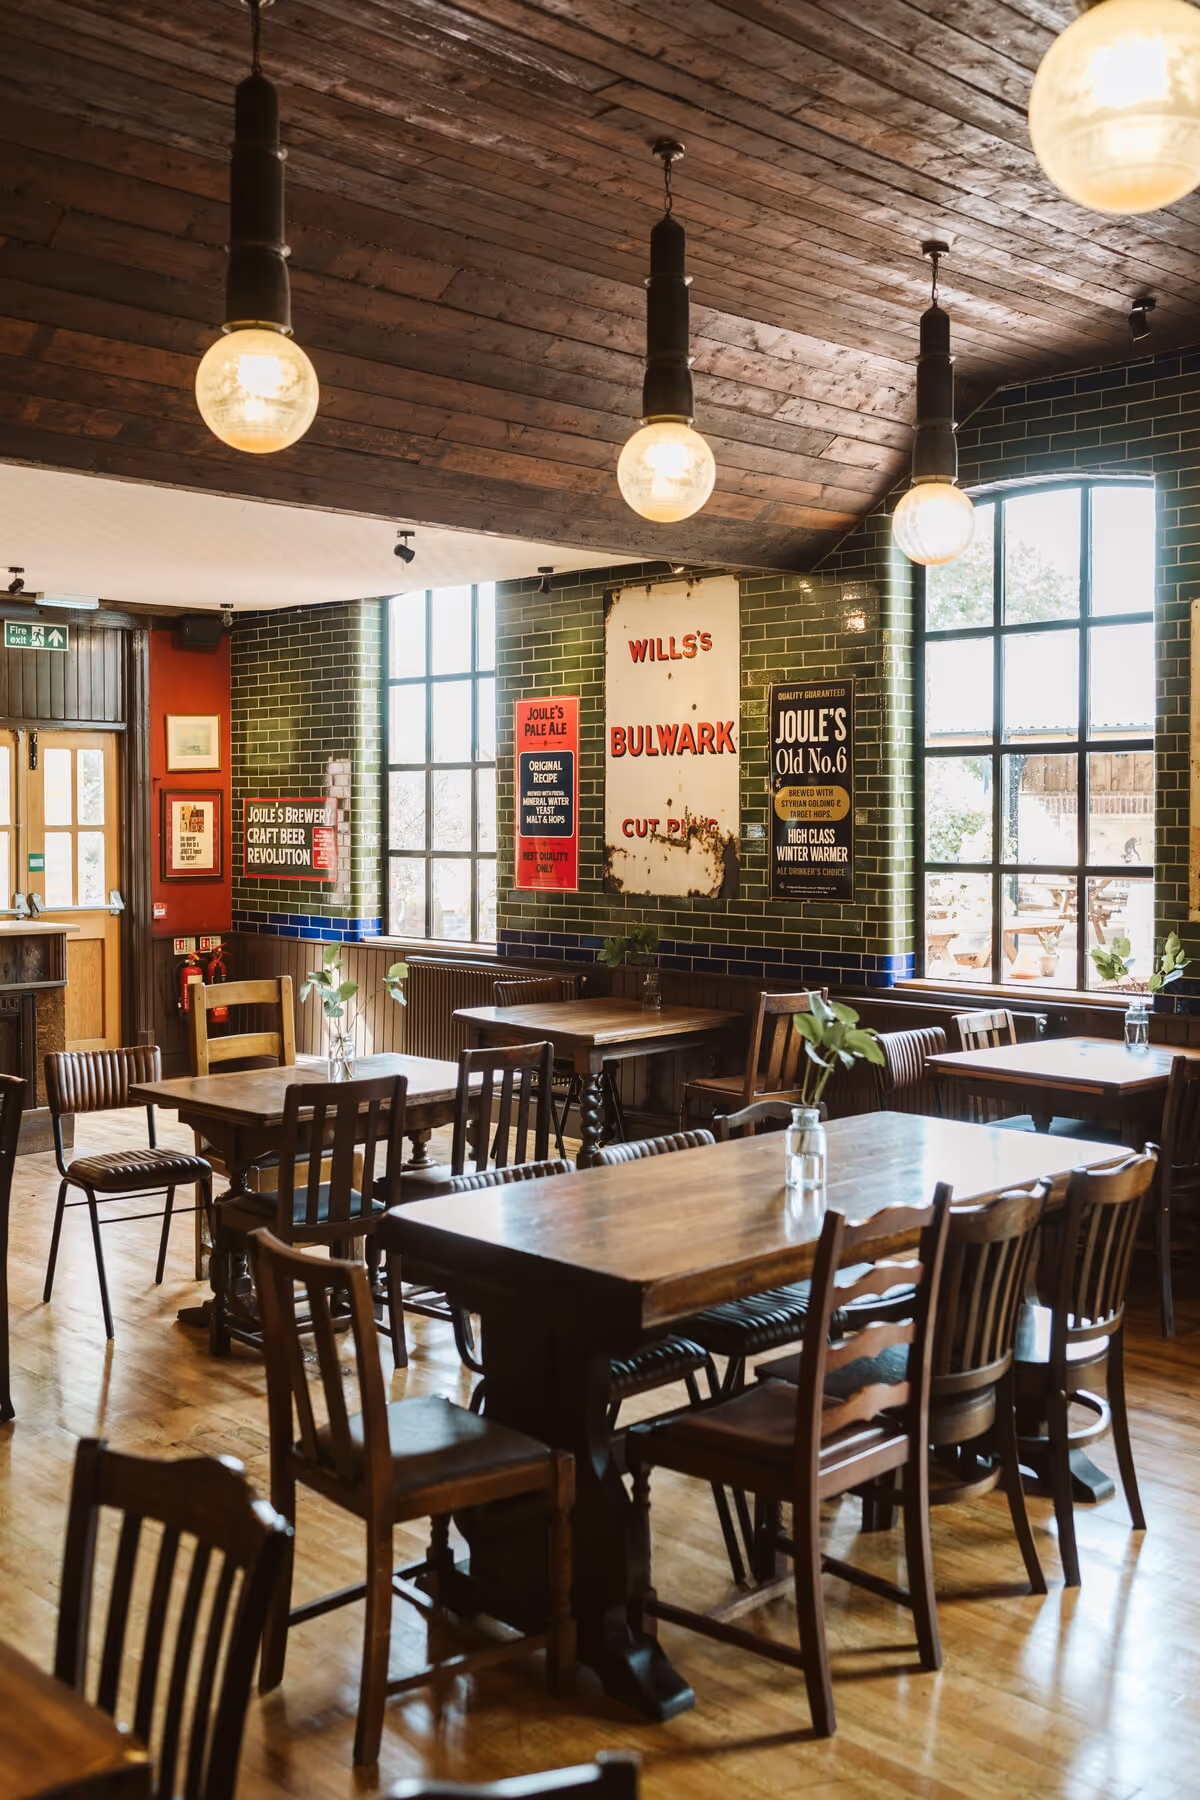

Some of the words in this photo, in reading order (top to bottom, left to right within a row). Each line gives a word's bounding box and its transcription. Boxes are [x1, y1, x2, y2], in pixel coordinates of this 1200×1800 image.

[10, 625, 27, 635] Fire
[10, 636, 27, 644] exit
[778, 691, 804, 700] QUALITY
[804, 688, 845, 699] GUARANTEED
[528, 705, 564, 720] JOULE'S
[524, 723, 546, 736] PALE
[549, 722, 567, 736] ALE
[775, 707, 847, 744] JOULE'S
[610, 721, 737, 758] BULWARK
[529, 761, 563, 771] ORIGINAL
[775, 747, 804, 775] Old
[533, 773, 558, 783] RECIPE
[789, 789, 814, 797] BREWED
[815, 788, 834, 797] WITH
[523, 797, 547, 806] MINERAL
[548, 797, 569, 806] WATER
[781, 800, 807, 808] STYRIAN
[808, 800, 835, 808] GOLDING
[248, 802, 284, 823] JOULE'S
[285, 806, 332, 824] BREWERY
[536, 806, 555, 815] YEAST
[790, 810, 812, 818] TARGET
[526, 816, 541, 824] MALT
[542, 816, 548, 824] &
[548, 816, 566, 824] HOPS
[622, 818, 660, 838] CUT
[667, 818, 718, 838] PLG
[247, 828, 278, 844] CRAFT
[280, 828, 305, 845] BEER
[788, 828, 807, 844] HIGH
[808, 828, 836, 844] CLASS
[248, 848, 311, 866] REVOLUTION
[523, 852, 538, 861] BEST
[540, 852, 569, 862] QUALITY
[776, 846, 808, 862] WINTER
[810, 846, 848, 862] WARMER
[536, 864, 554, 873] ONLY
[776, 867, 787, 875] ALE
[789, 867, 821, 876] DRINKER'S
[822, 868, 846, 877] CHOICE
